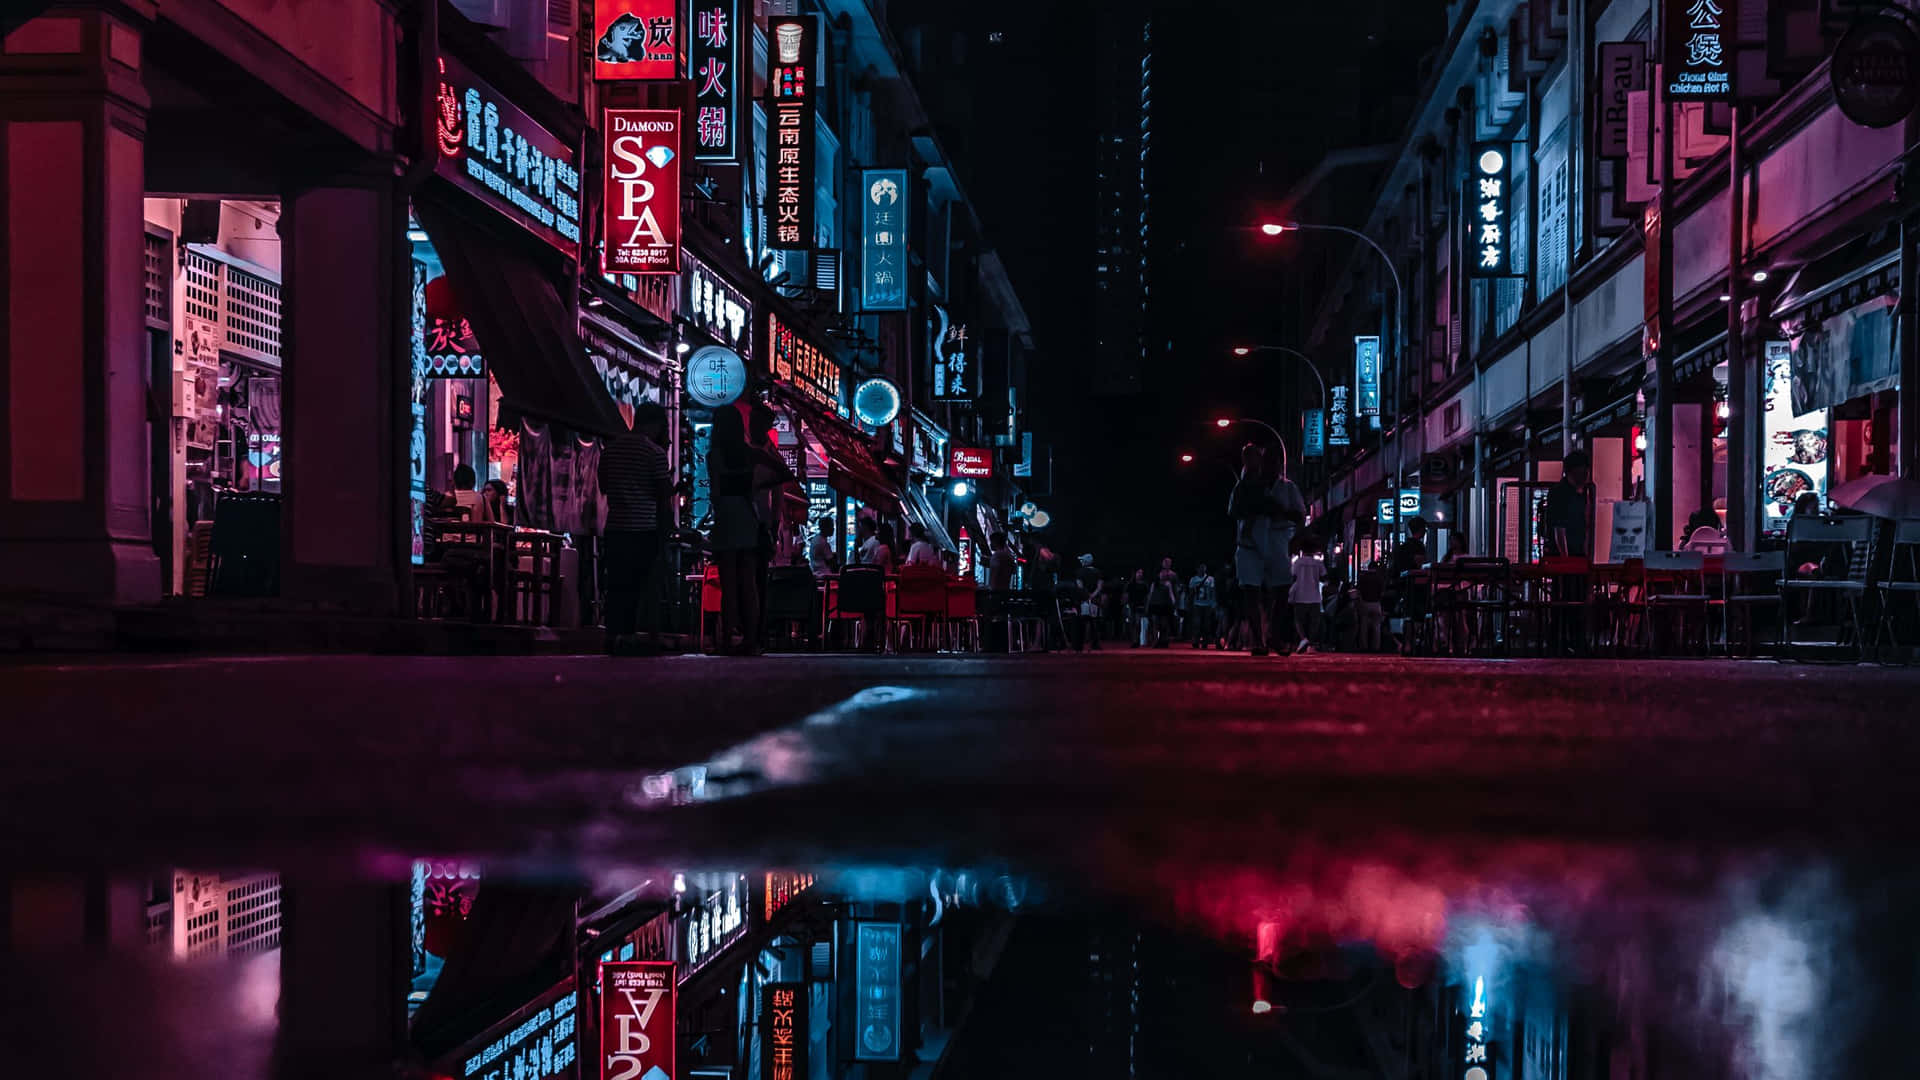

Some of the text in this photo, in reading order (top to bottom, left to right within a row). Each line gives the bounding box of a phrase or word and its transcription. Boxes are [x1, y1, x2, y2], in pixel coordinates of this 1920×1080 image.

[648, 16, 673, 48] 炭
[697, 7, 728, 148] 味火锅
[614, 117, 674, 132] DIAMOND
[611, 136, 673, 247] SPA
[778, 109, 800, 242] 云南原生态火锅
[617, 249, 630, 257] Tel:
[630, 256, 647, 265] (2nd
[648, 256, 669, 265] Floor)
